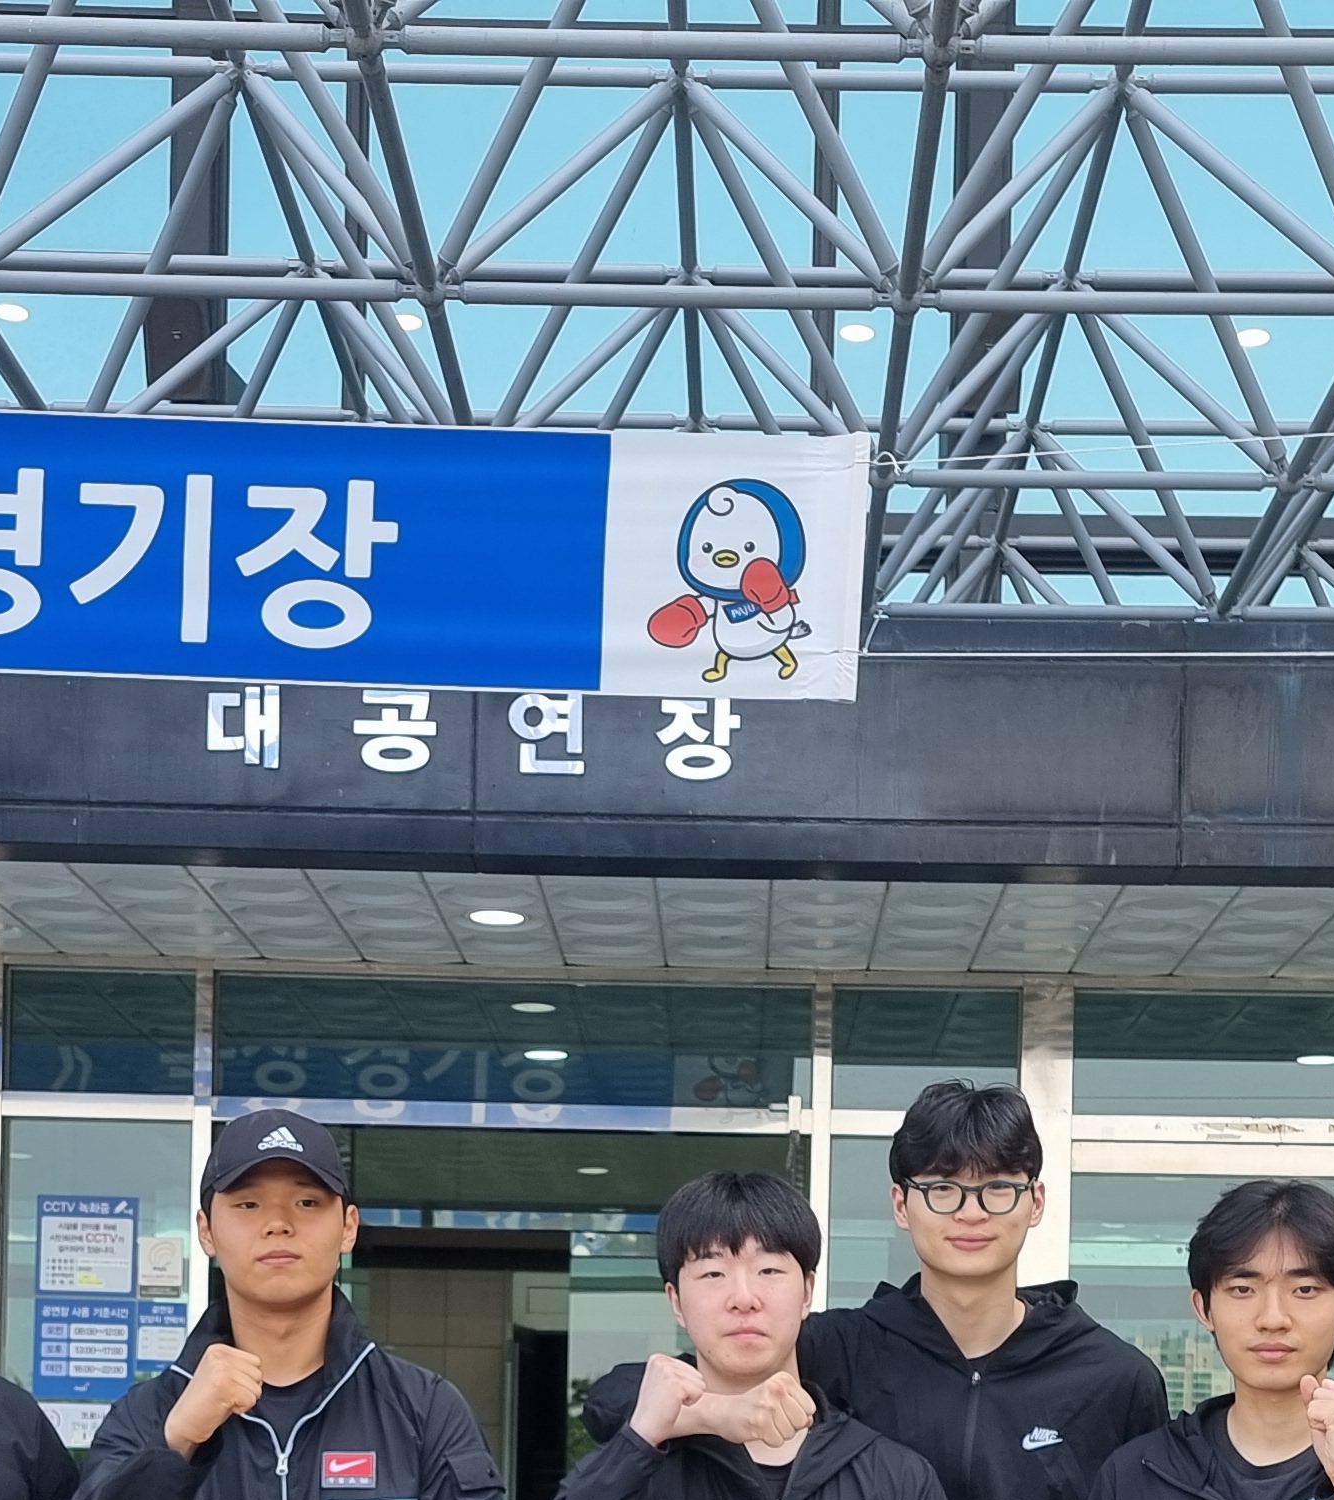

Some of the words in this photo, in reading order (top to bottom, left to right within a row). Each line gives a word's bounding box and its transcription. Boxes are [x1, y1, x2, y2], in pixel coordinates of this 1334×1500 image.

[42, 1201, 76, 1213] CCTV
[78, 1202, 111, 1215] 녹화중
[1030, 1426, 1059, 1442] NIKE
